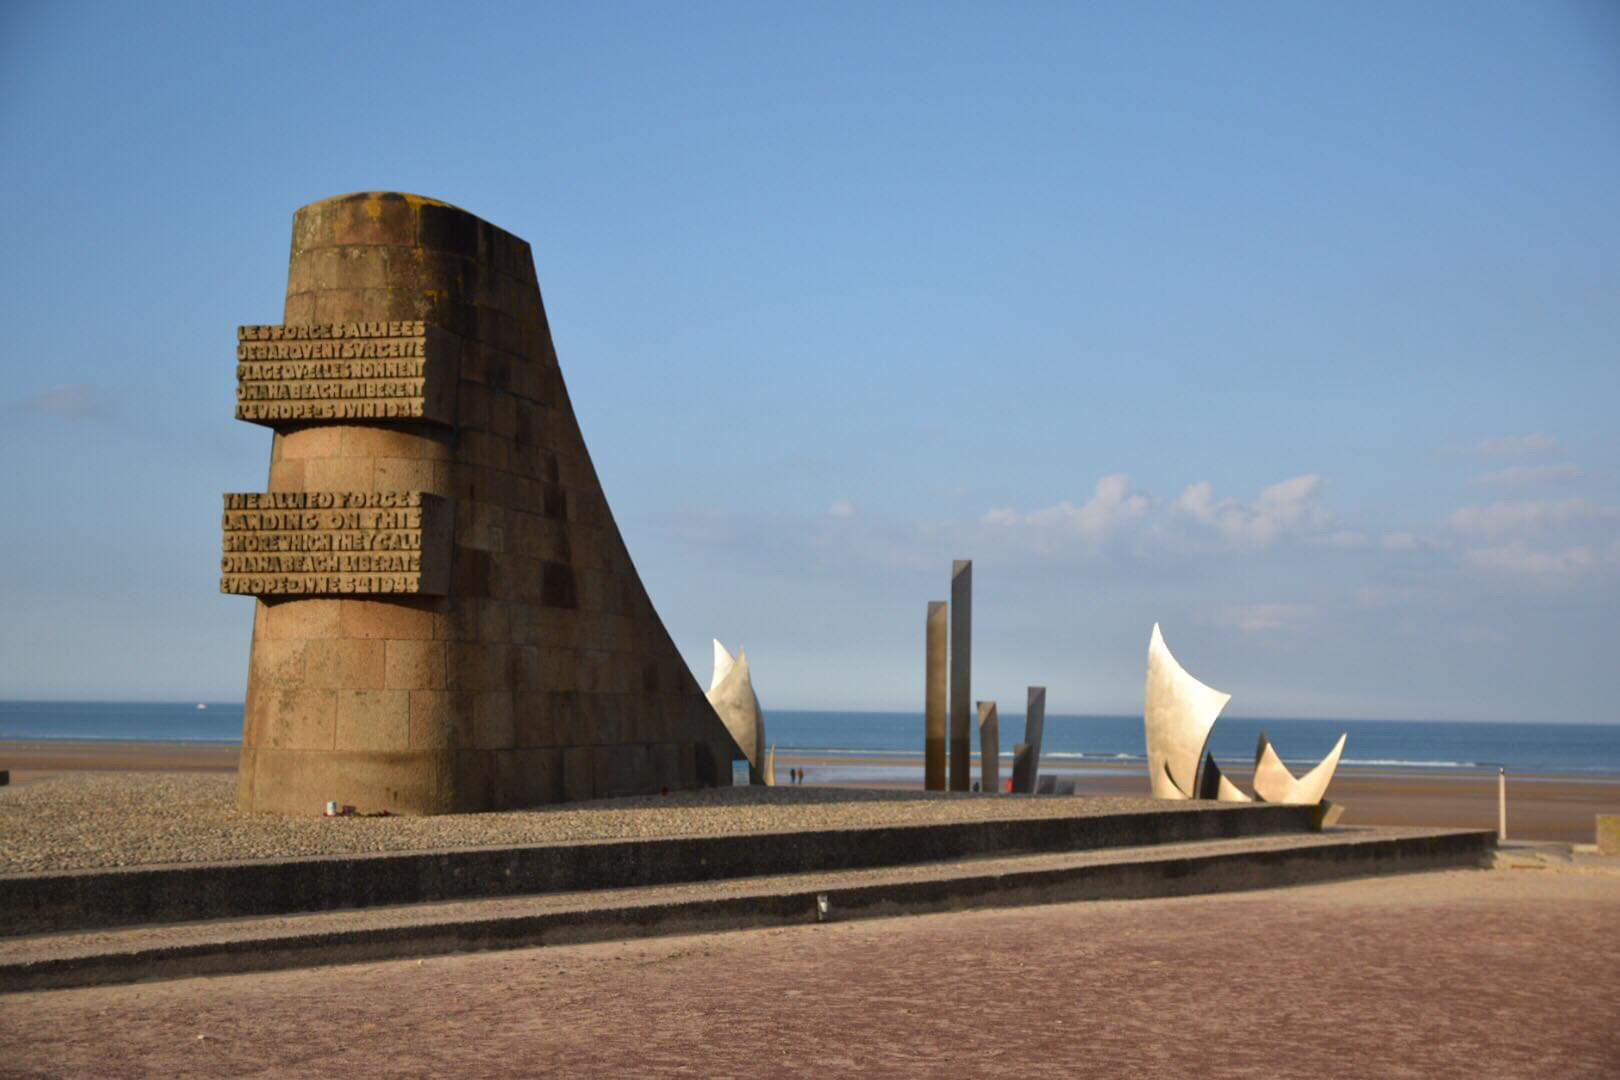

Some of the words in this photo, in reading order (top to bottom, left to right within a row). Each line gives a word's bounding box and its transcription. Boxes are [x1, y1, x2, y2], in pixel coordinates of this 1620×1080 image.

[273, 323, 345, 340] FORCES
[346, 320, 425, 338] ALLIEES
[378, 340, 425, 357] CETTE
[237, 363, 282, 380] PLAGE
[352, 359, 425, 378] NOMMENT
[237, 383, 290, 400] OMAHA
[291, 382, 341, 400] BEACH
[353, 379, 424, 398] LIBERENT
[224, 493, 257, 509] THE
[259, 492, 334, 509] ALLIED
[337, 491, 421, 508] FORCES
[223, 513, 319, 530] LANDING
[329, 512, 360, 529] ON
[370, 510, 421, 529] THIS
[223, 533, 279, 551] SHORE
[279, 533, 332, 552] WHICH
[333, 532, 376, 551] THEY
[377, 532, 421, 550] CALL
[222, 556, 282, 572] OMAHA
[283, 555, 340, 573] BEACH
[341, 553, 421, 572] LIBERATE
